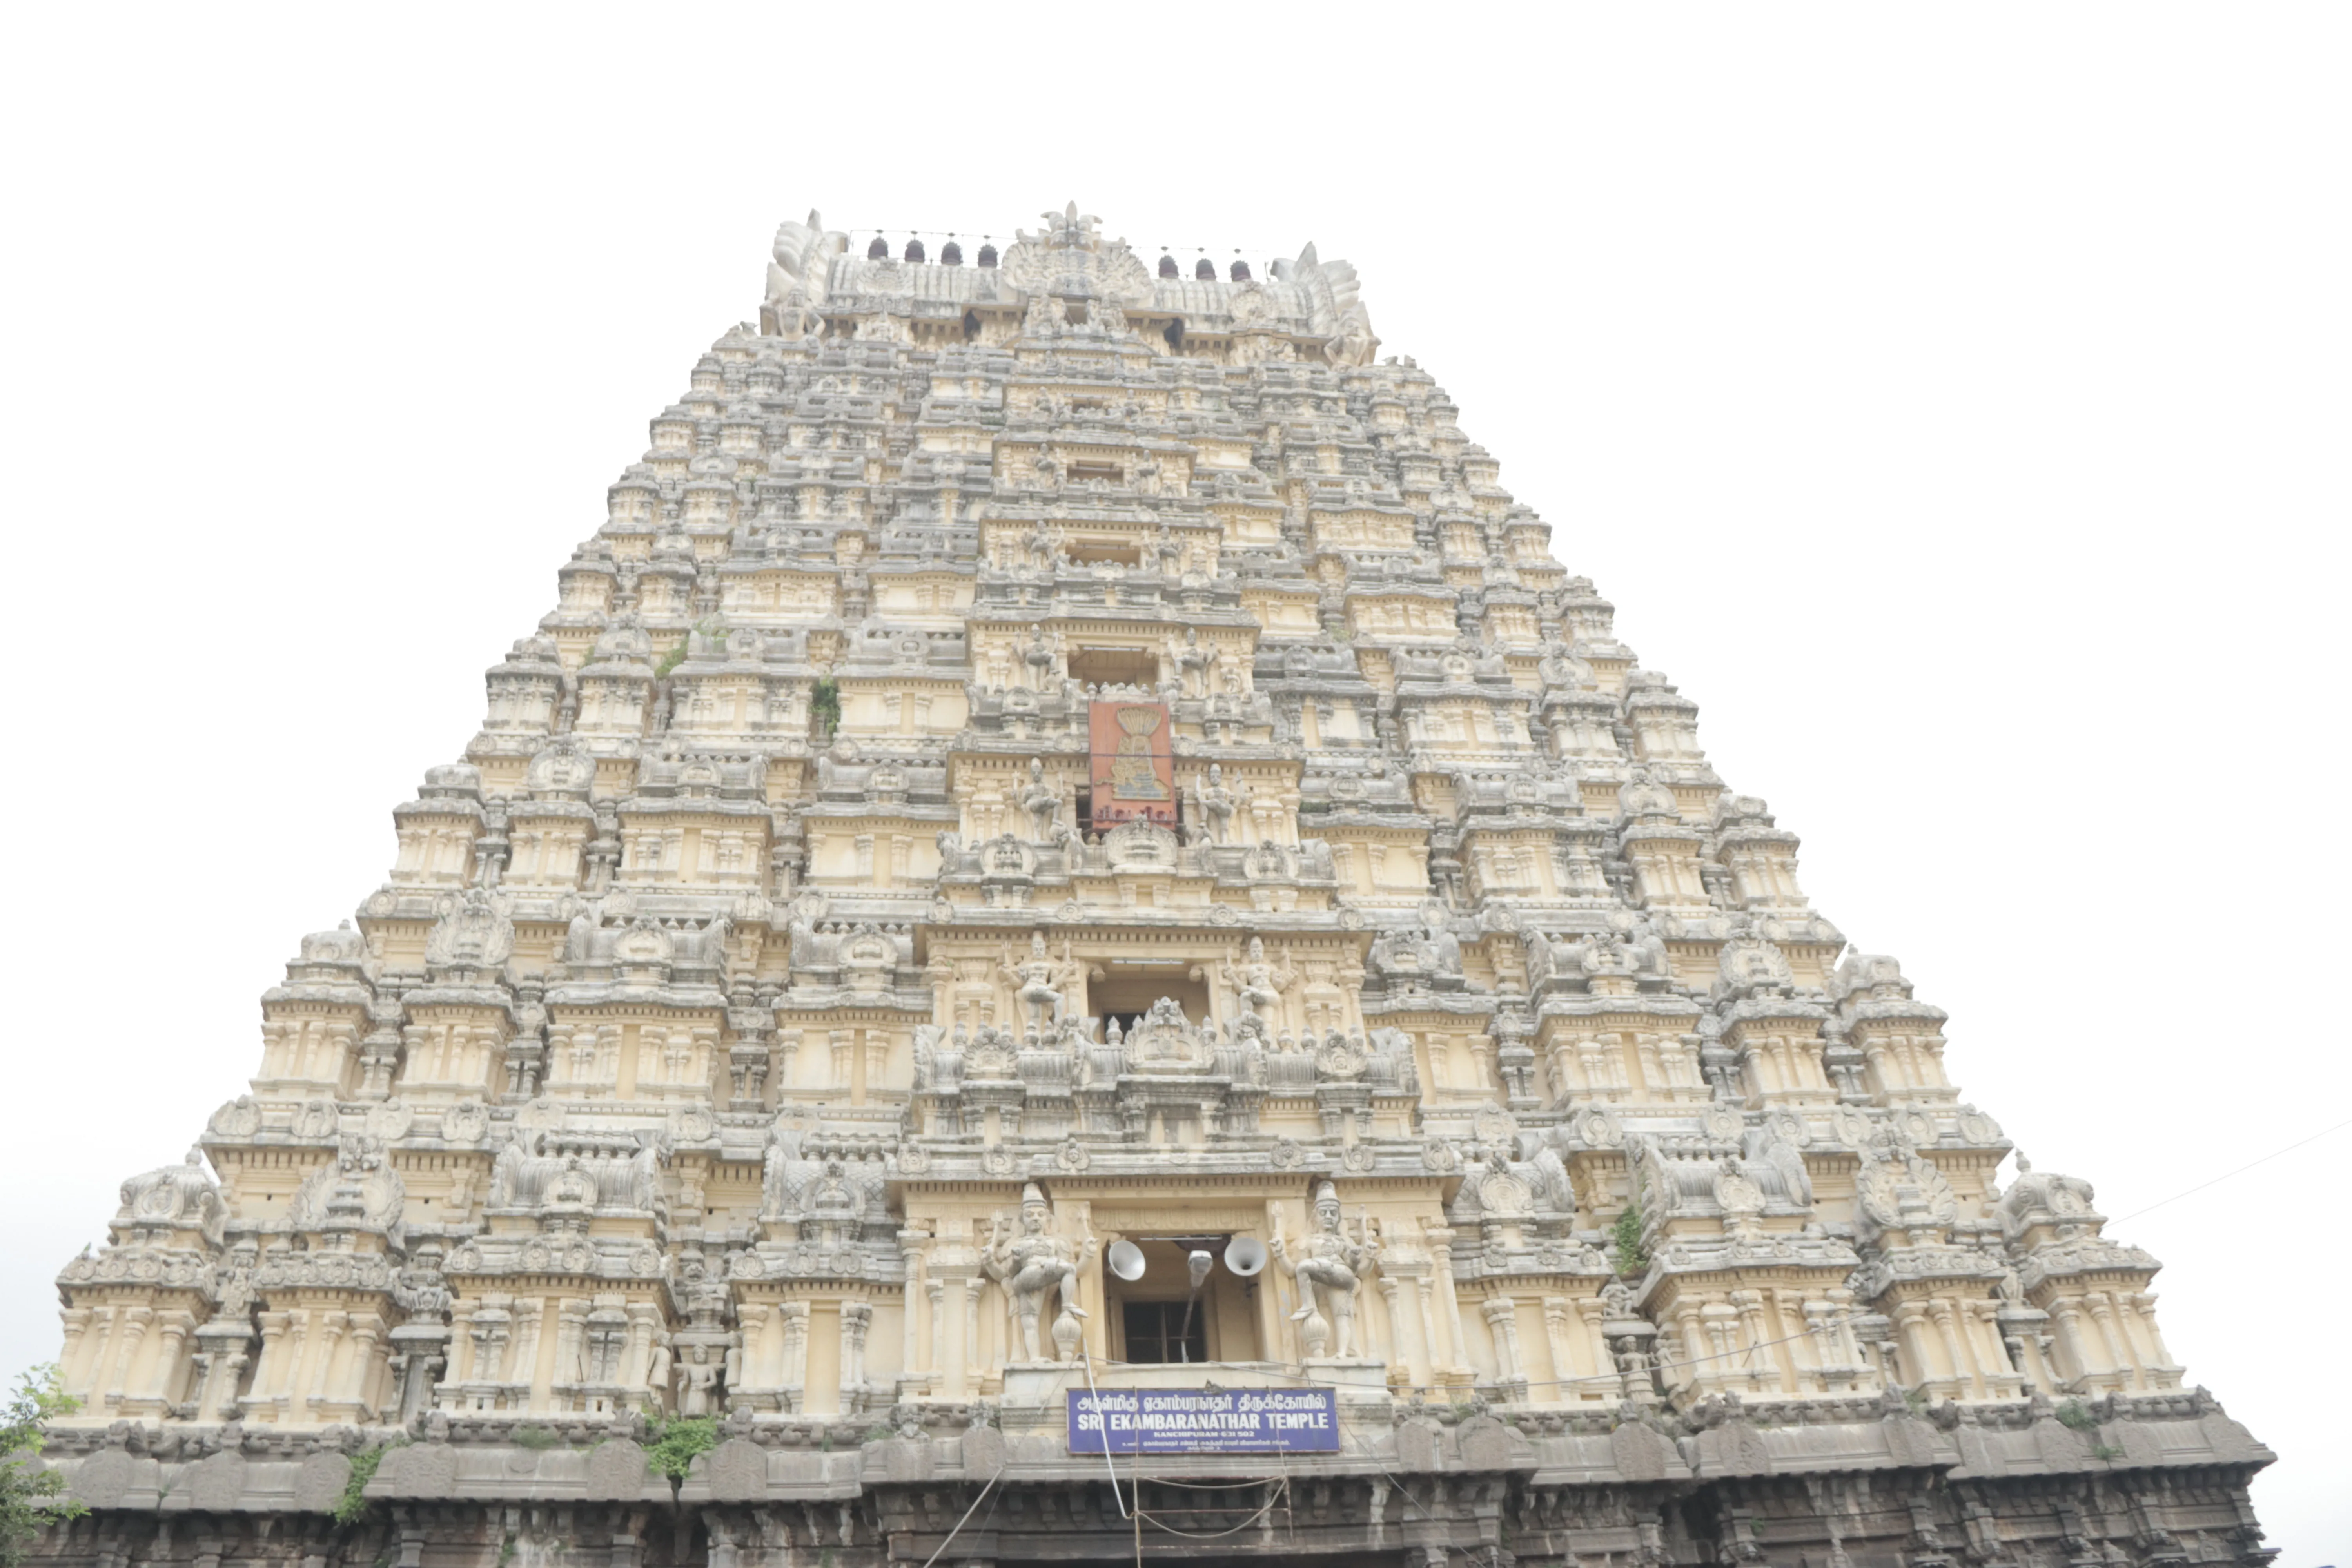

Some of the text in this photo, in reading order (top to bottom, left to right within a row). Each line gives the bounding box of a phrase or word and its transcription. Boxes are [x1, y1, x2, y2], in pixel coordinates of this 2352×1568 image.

[1077, 1394, 1326, 1413] அருள்மிகு ஏகாம்பரநாதர் திருக்கோயில்
[1078, 1413, 1329, 1430] SRI EKAMBARANATHAR TEMPLE
